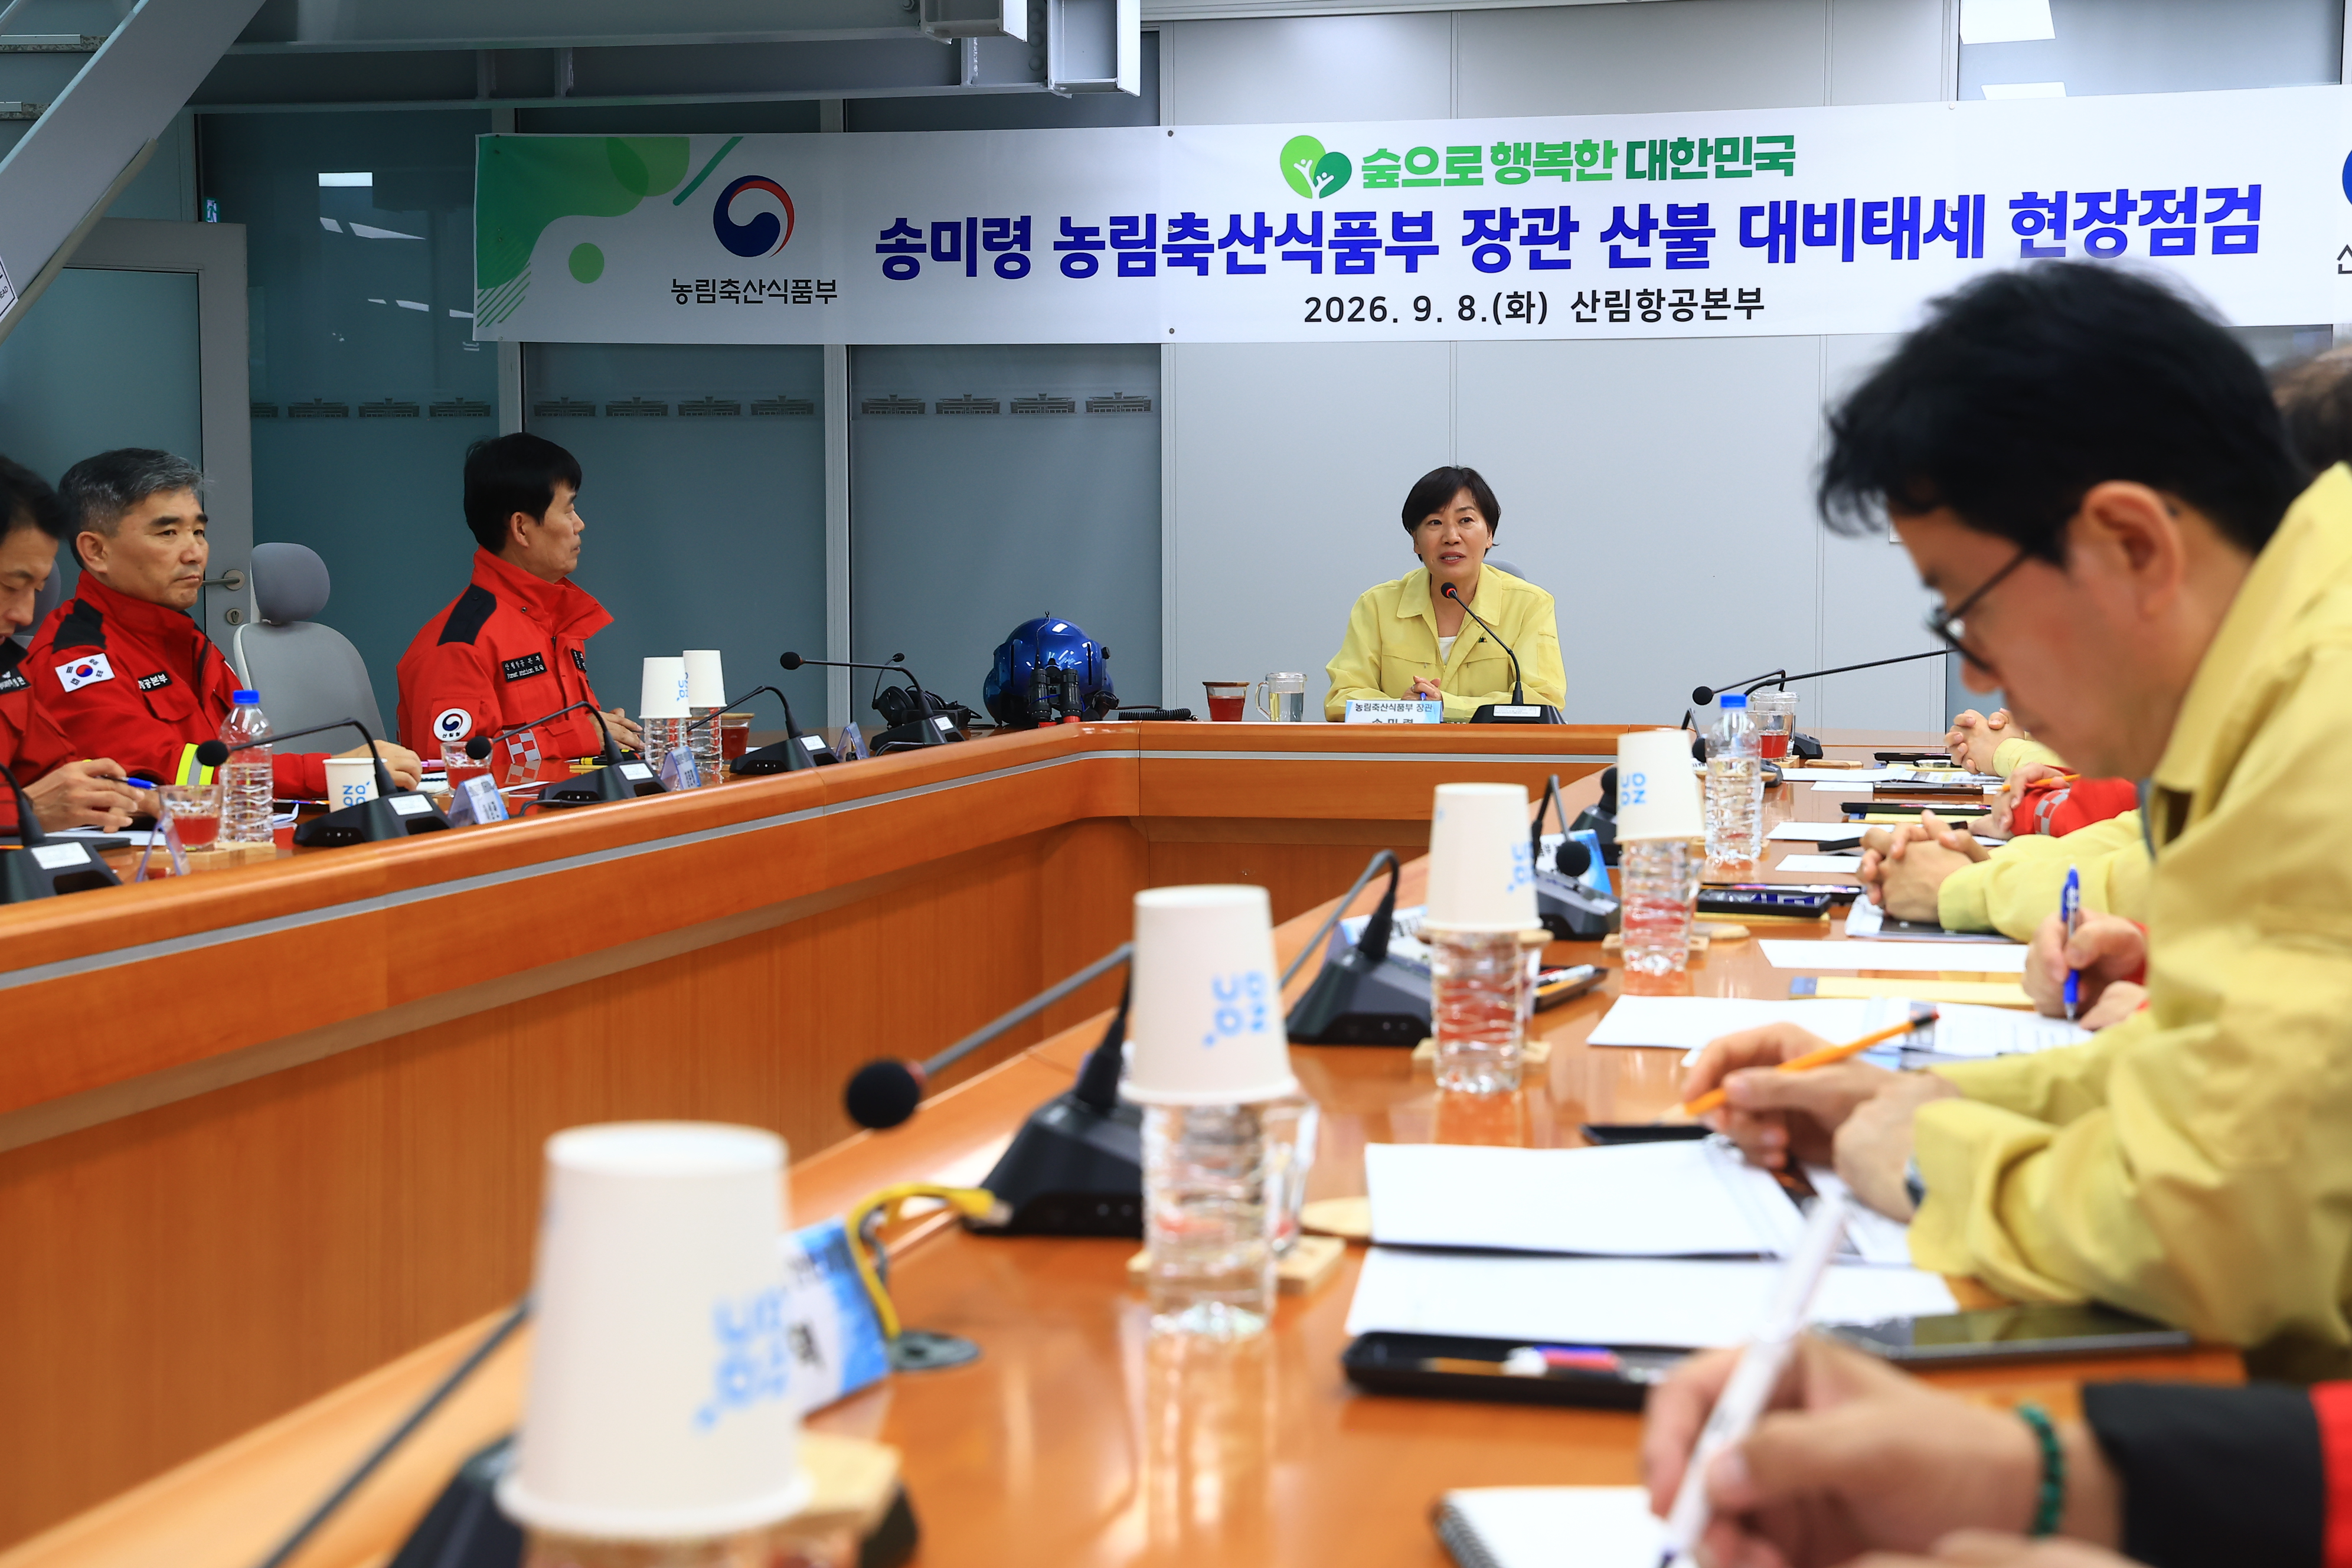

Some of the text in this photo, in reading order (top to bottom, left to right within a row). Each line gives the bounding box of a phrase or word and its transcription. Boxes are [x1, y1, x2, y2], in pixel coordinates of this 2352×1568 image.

[1362, 135, 1796, 188] 숲으로 행복한 대한민국
[876, 184, 2262, 280] 송미령 농림축산식품부 장관 산불 대비태세 현장점검
[0, 286, 8, 300] EAD
[671, 278, 838, 305] 농림축산식품부
[1304, 288, 1765, 325] 2026. 9. 8.(화) 산림항공본부
[1355, 703, 1433, 713] 농림축산식품부 장관
